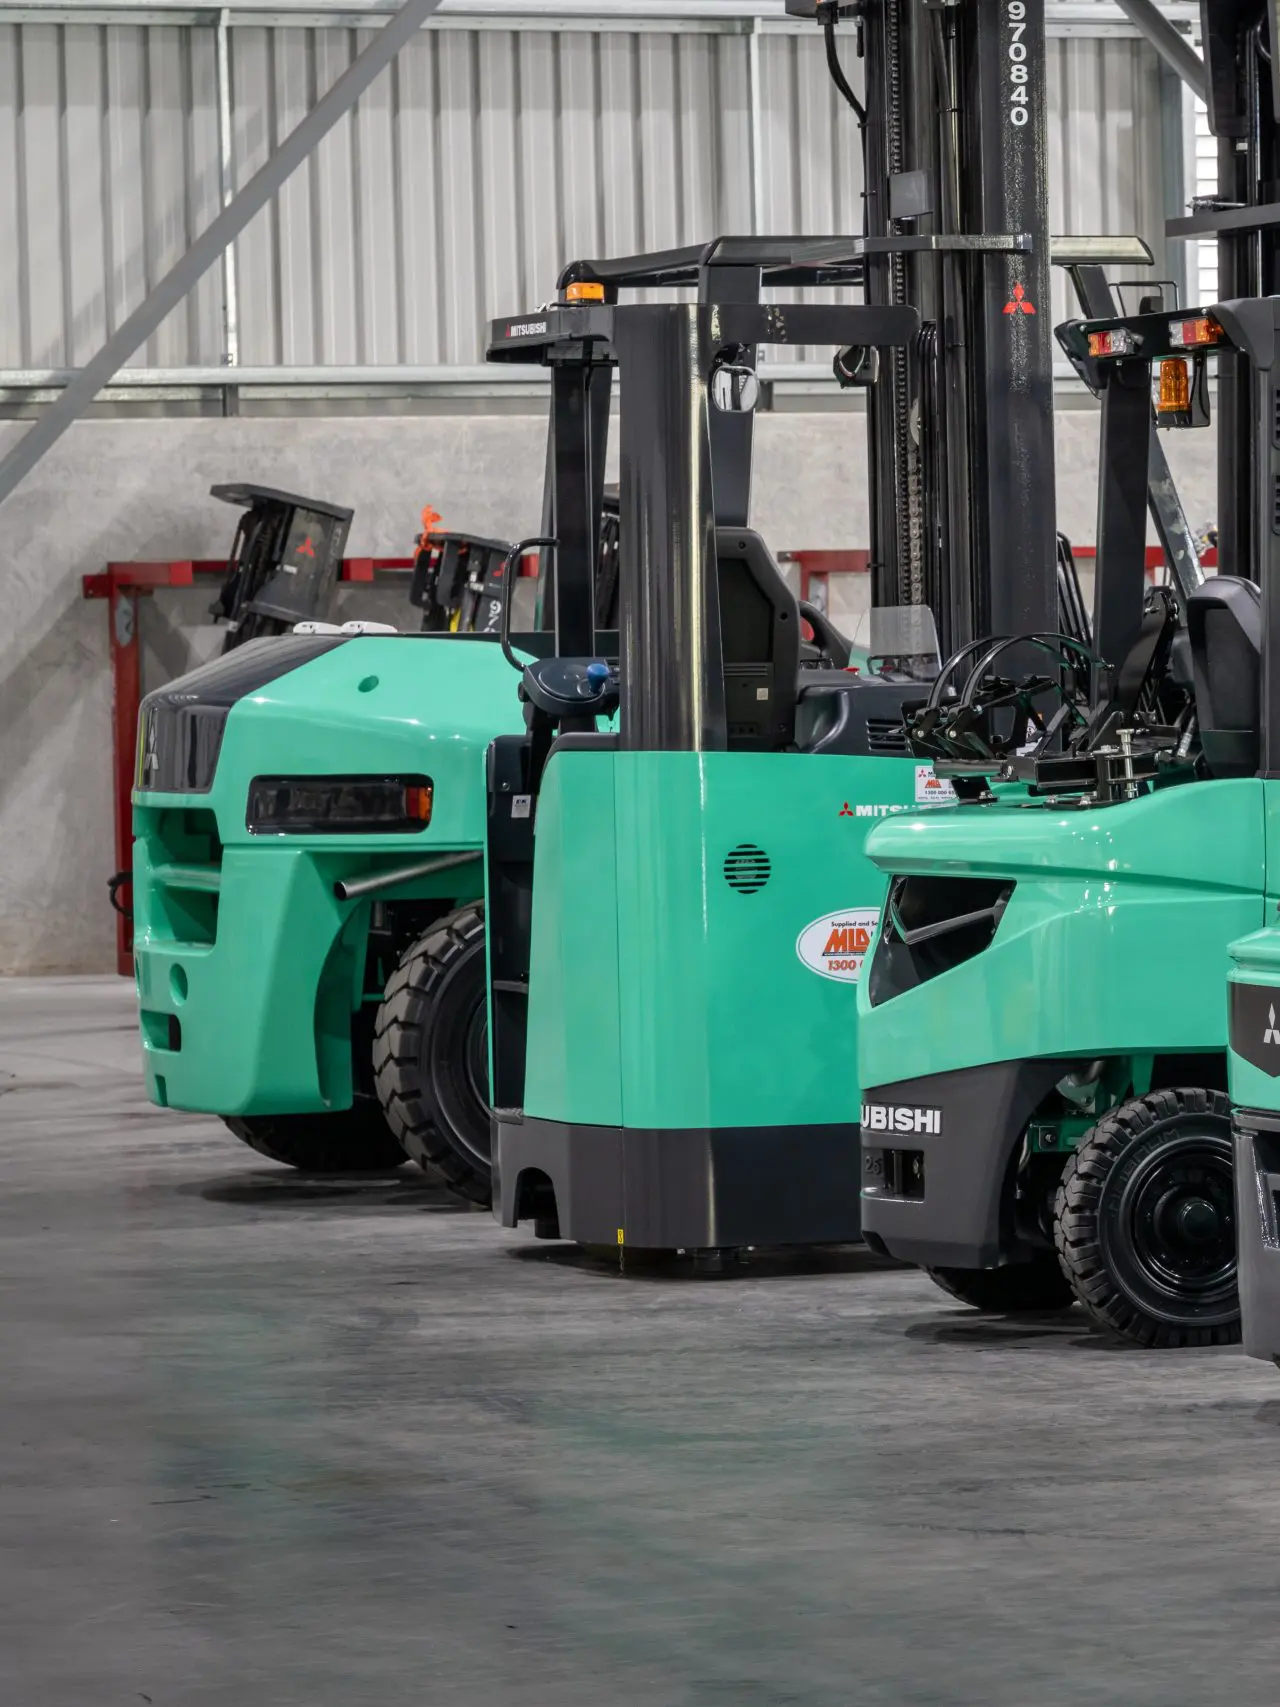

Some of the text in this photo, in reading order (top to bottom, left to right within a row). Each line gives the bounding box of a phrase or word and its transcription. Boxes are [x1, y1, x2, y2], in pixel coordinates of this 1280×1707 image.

[1007, 1, 1029, 126] 970840
[483, 600, 502, 633] 97
[856, 804, 908, 817] MITS
[828, 959, 857, 971] 1300
